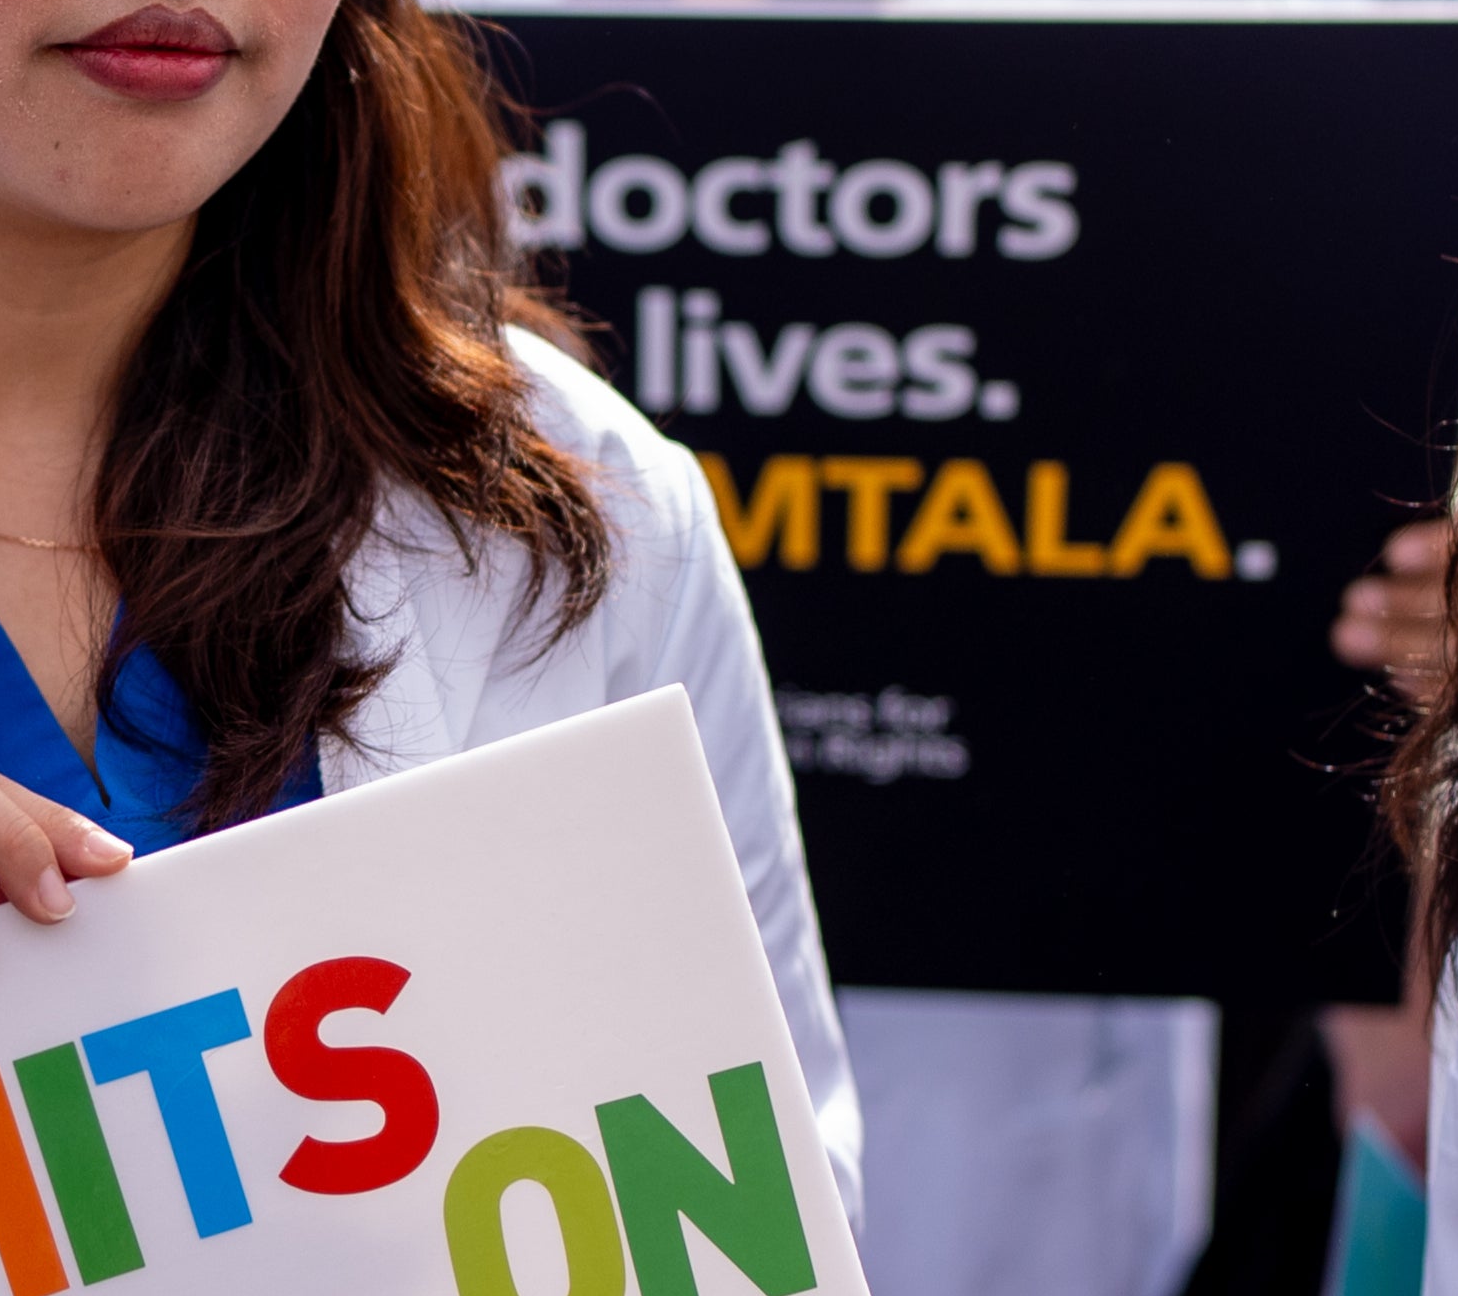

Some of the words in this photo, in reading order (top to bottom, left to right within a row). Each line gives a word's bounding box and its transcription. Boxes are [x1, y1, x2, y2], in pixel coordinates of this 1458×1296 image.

[502, 117, 1080, 261] doctors
[632, 284, 1022, 422] lives.
[697, 451, 1280, 582] MTALA.
